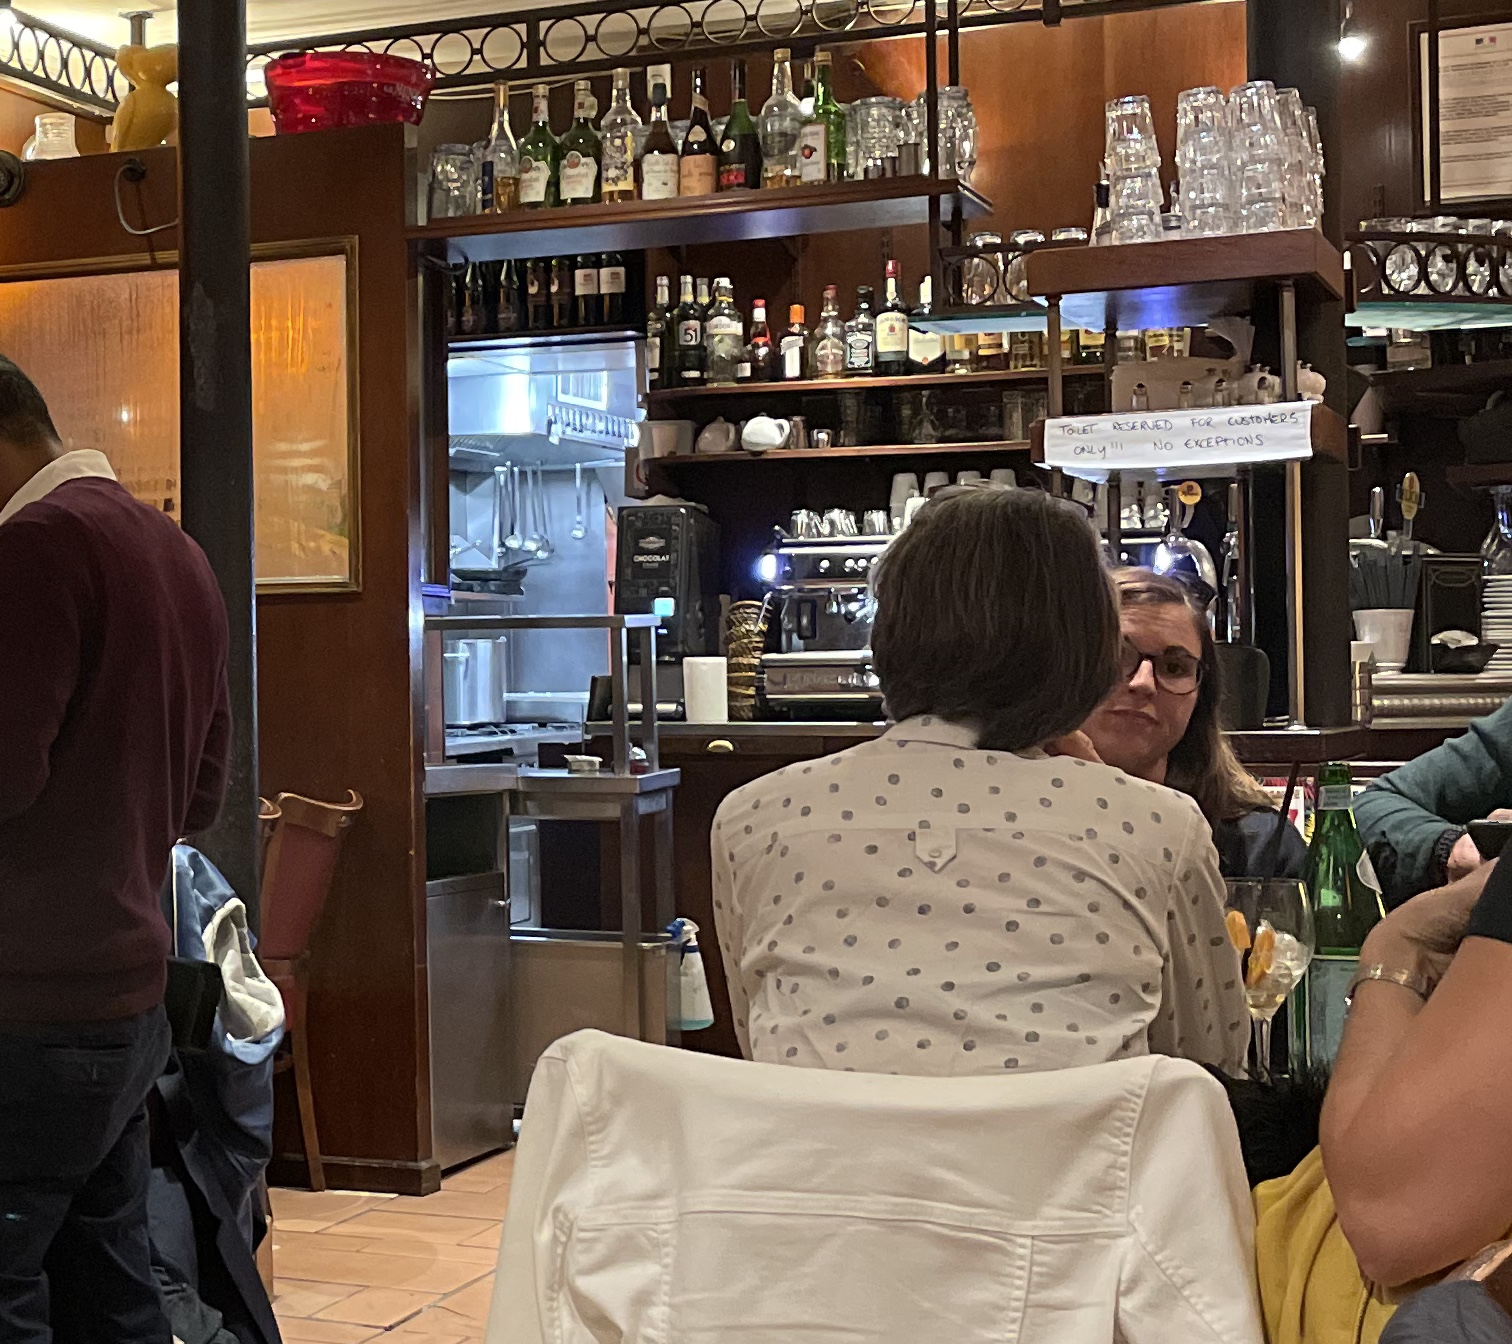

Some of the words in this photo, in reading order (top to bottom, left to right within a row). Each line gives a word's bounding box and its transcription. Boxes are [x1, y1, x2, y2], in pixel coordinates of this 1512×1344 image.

[684, 328, 698, 343] 51
[1059, 422, 1099, 436] TOILET
[1112, 418, 1174, 432] RESERVED
[1191, 417, 1217, 428] FOR
[1228, 411, 1299, 426] CUSTOMERS
[1153, 439, 1174, 451] NO
[1184, 434, 1264, 450] EXCEPTIONS
